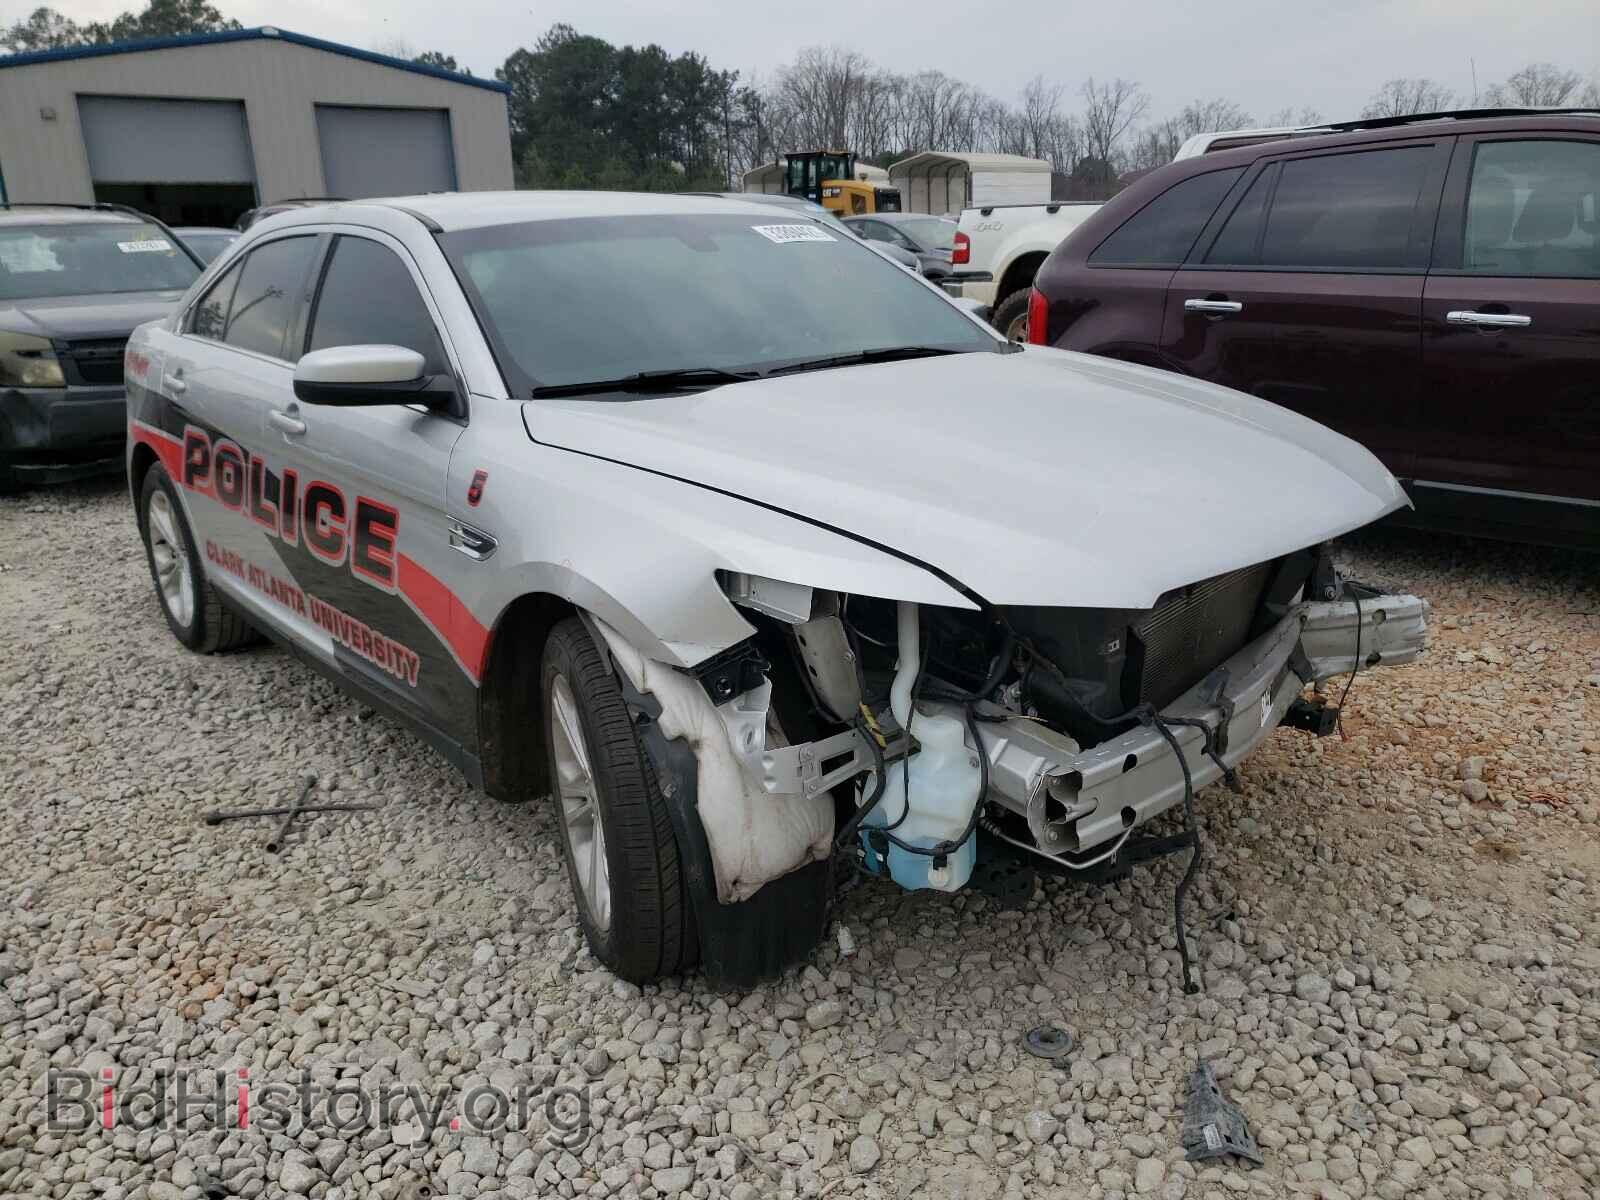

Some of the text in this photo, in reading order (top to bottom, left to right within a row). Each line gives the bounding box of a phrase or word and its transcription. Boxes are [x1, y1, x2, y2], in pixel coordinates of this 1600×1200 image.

[184, 425, 399, 593] POLICE
[467, 468, 489, 508] 5
[206, 540, 420, 687] CLARK ATLANTA UNIVERSITY
